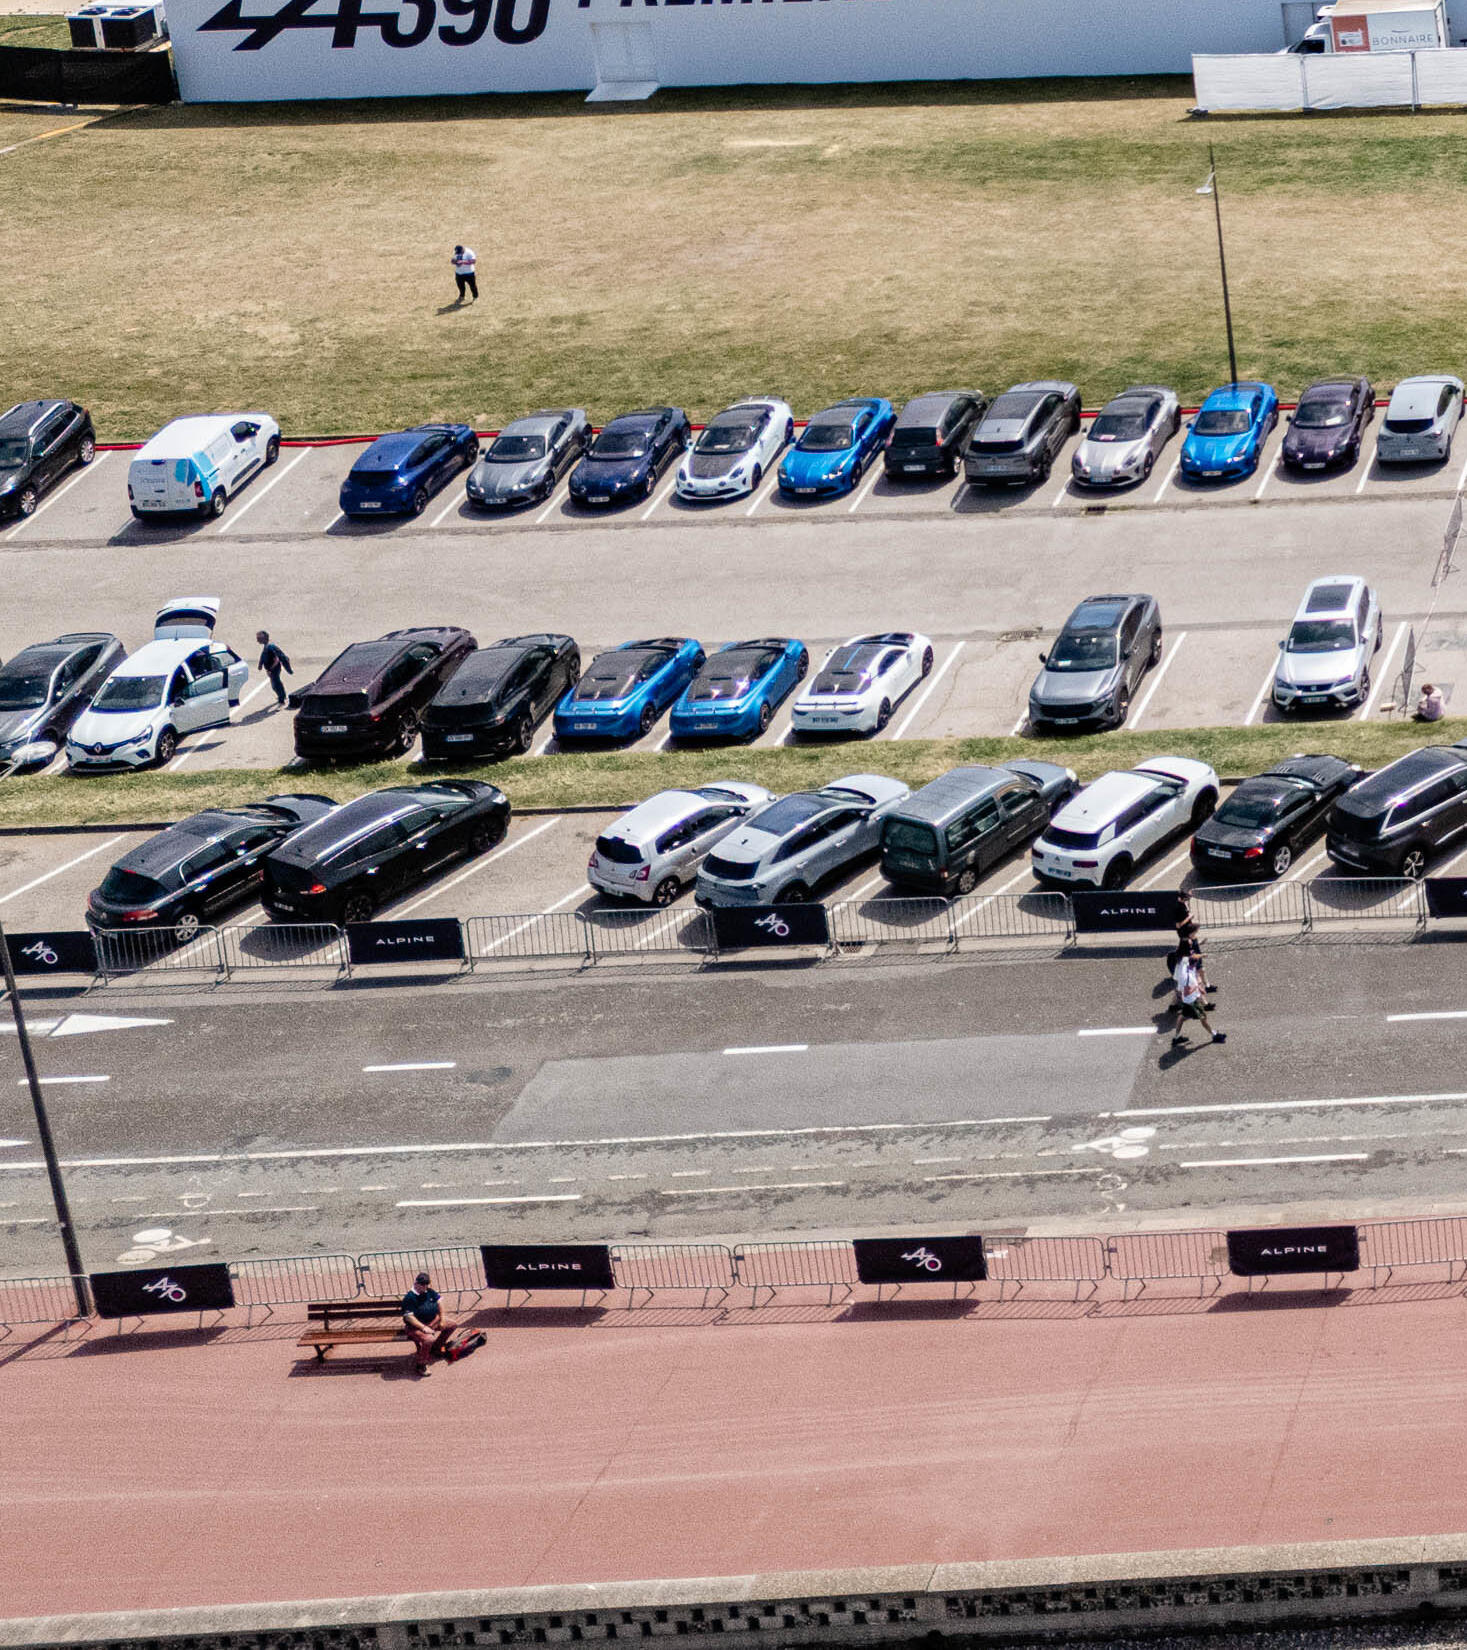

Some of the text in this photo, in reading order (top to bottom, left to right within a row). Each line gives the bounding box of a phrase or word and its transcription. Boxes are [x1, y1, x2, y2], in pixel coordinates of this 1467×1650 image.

[1372, 33, 1435, 46] BONNAIRE
[1099, 907, 1156, 915] ALPINE
[376, 936, 436, 945] ALPINE
[1261, 1245, 1327, 1255] ALPINE
[515, 1263, 582, 1271] ALPINE
